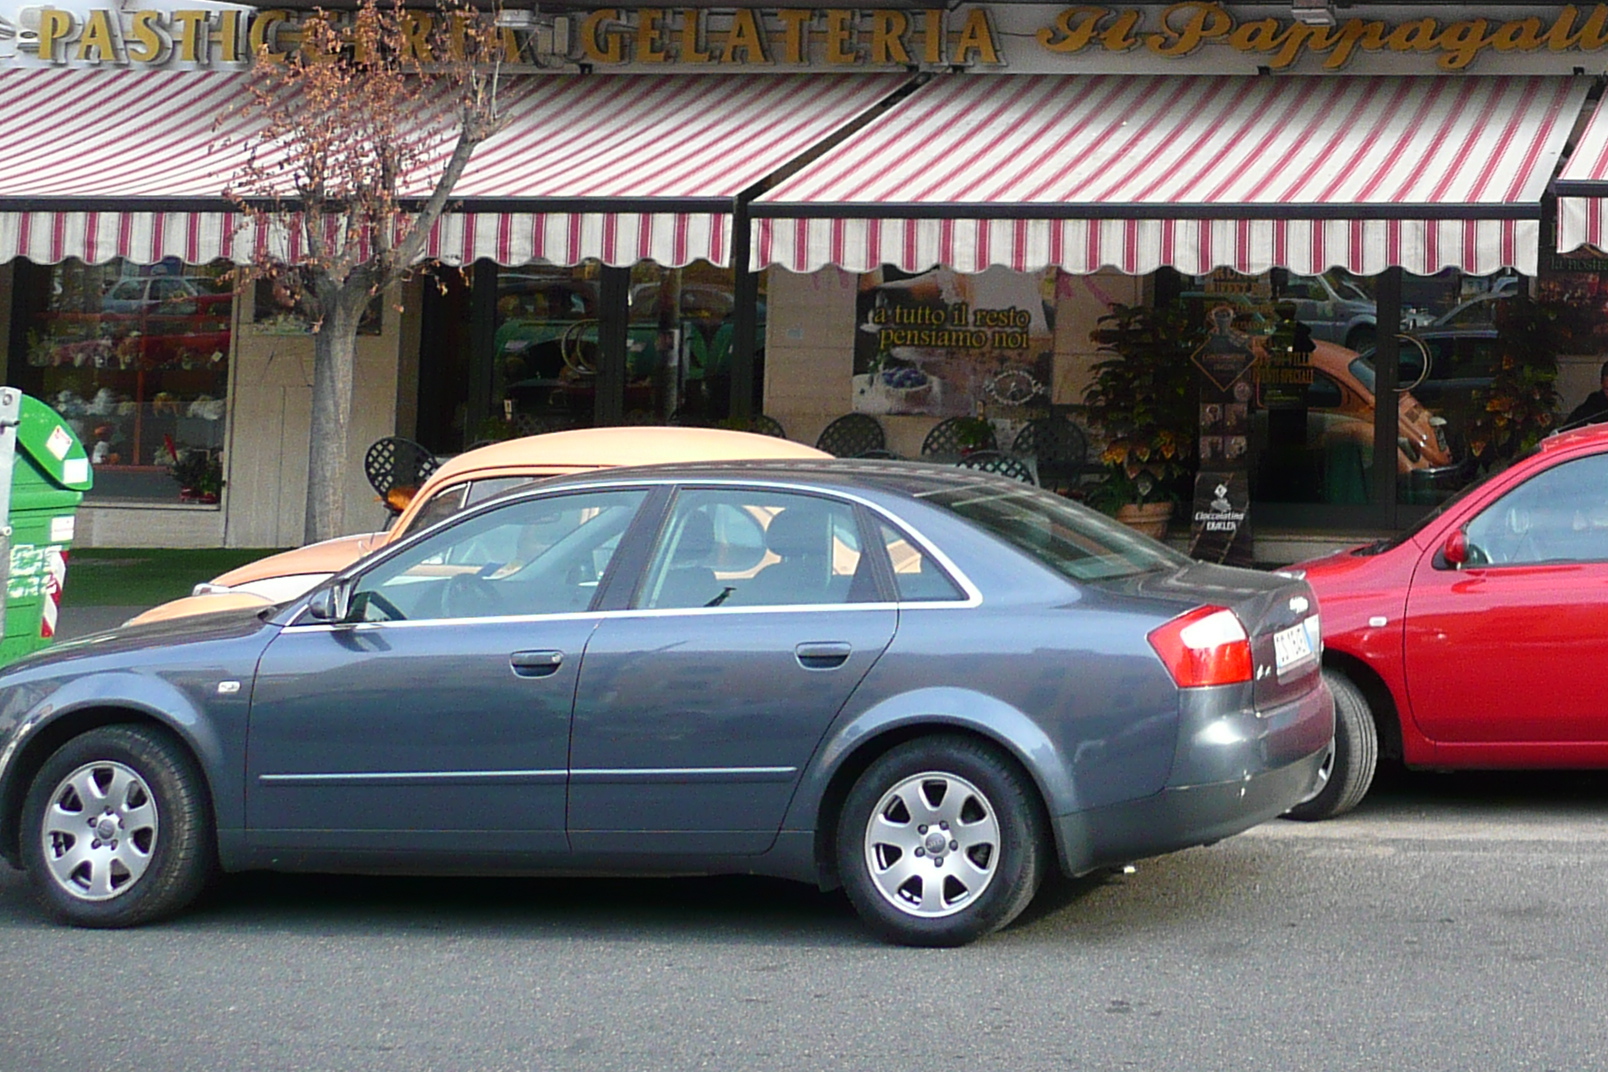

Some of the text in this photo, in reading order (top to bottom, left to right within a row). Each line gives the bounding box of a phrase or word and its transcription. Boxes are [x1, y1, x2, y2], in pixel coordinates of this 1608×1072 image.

[581, 8, 1000, 64] GELATERIA
[1036, 5, 1138, 52] Il
[873, 302, 1030, 326] a tutto il resto
[879, 328, 1030, 349] pensiamo noi
